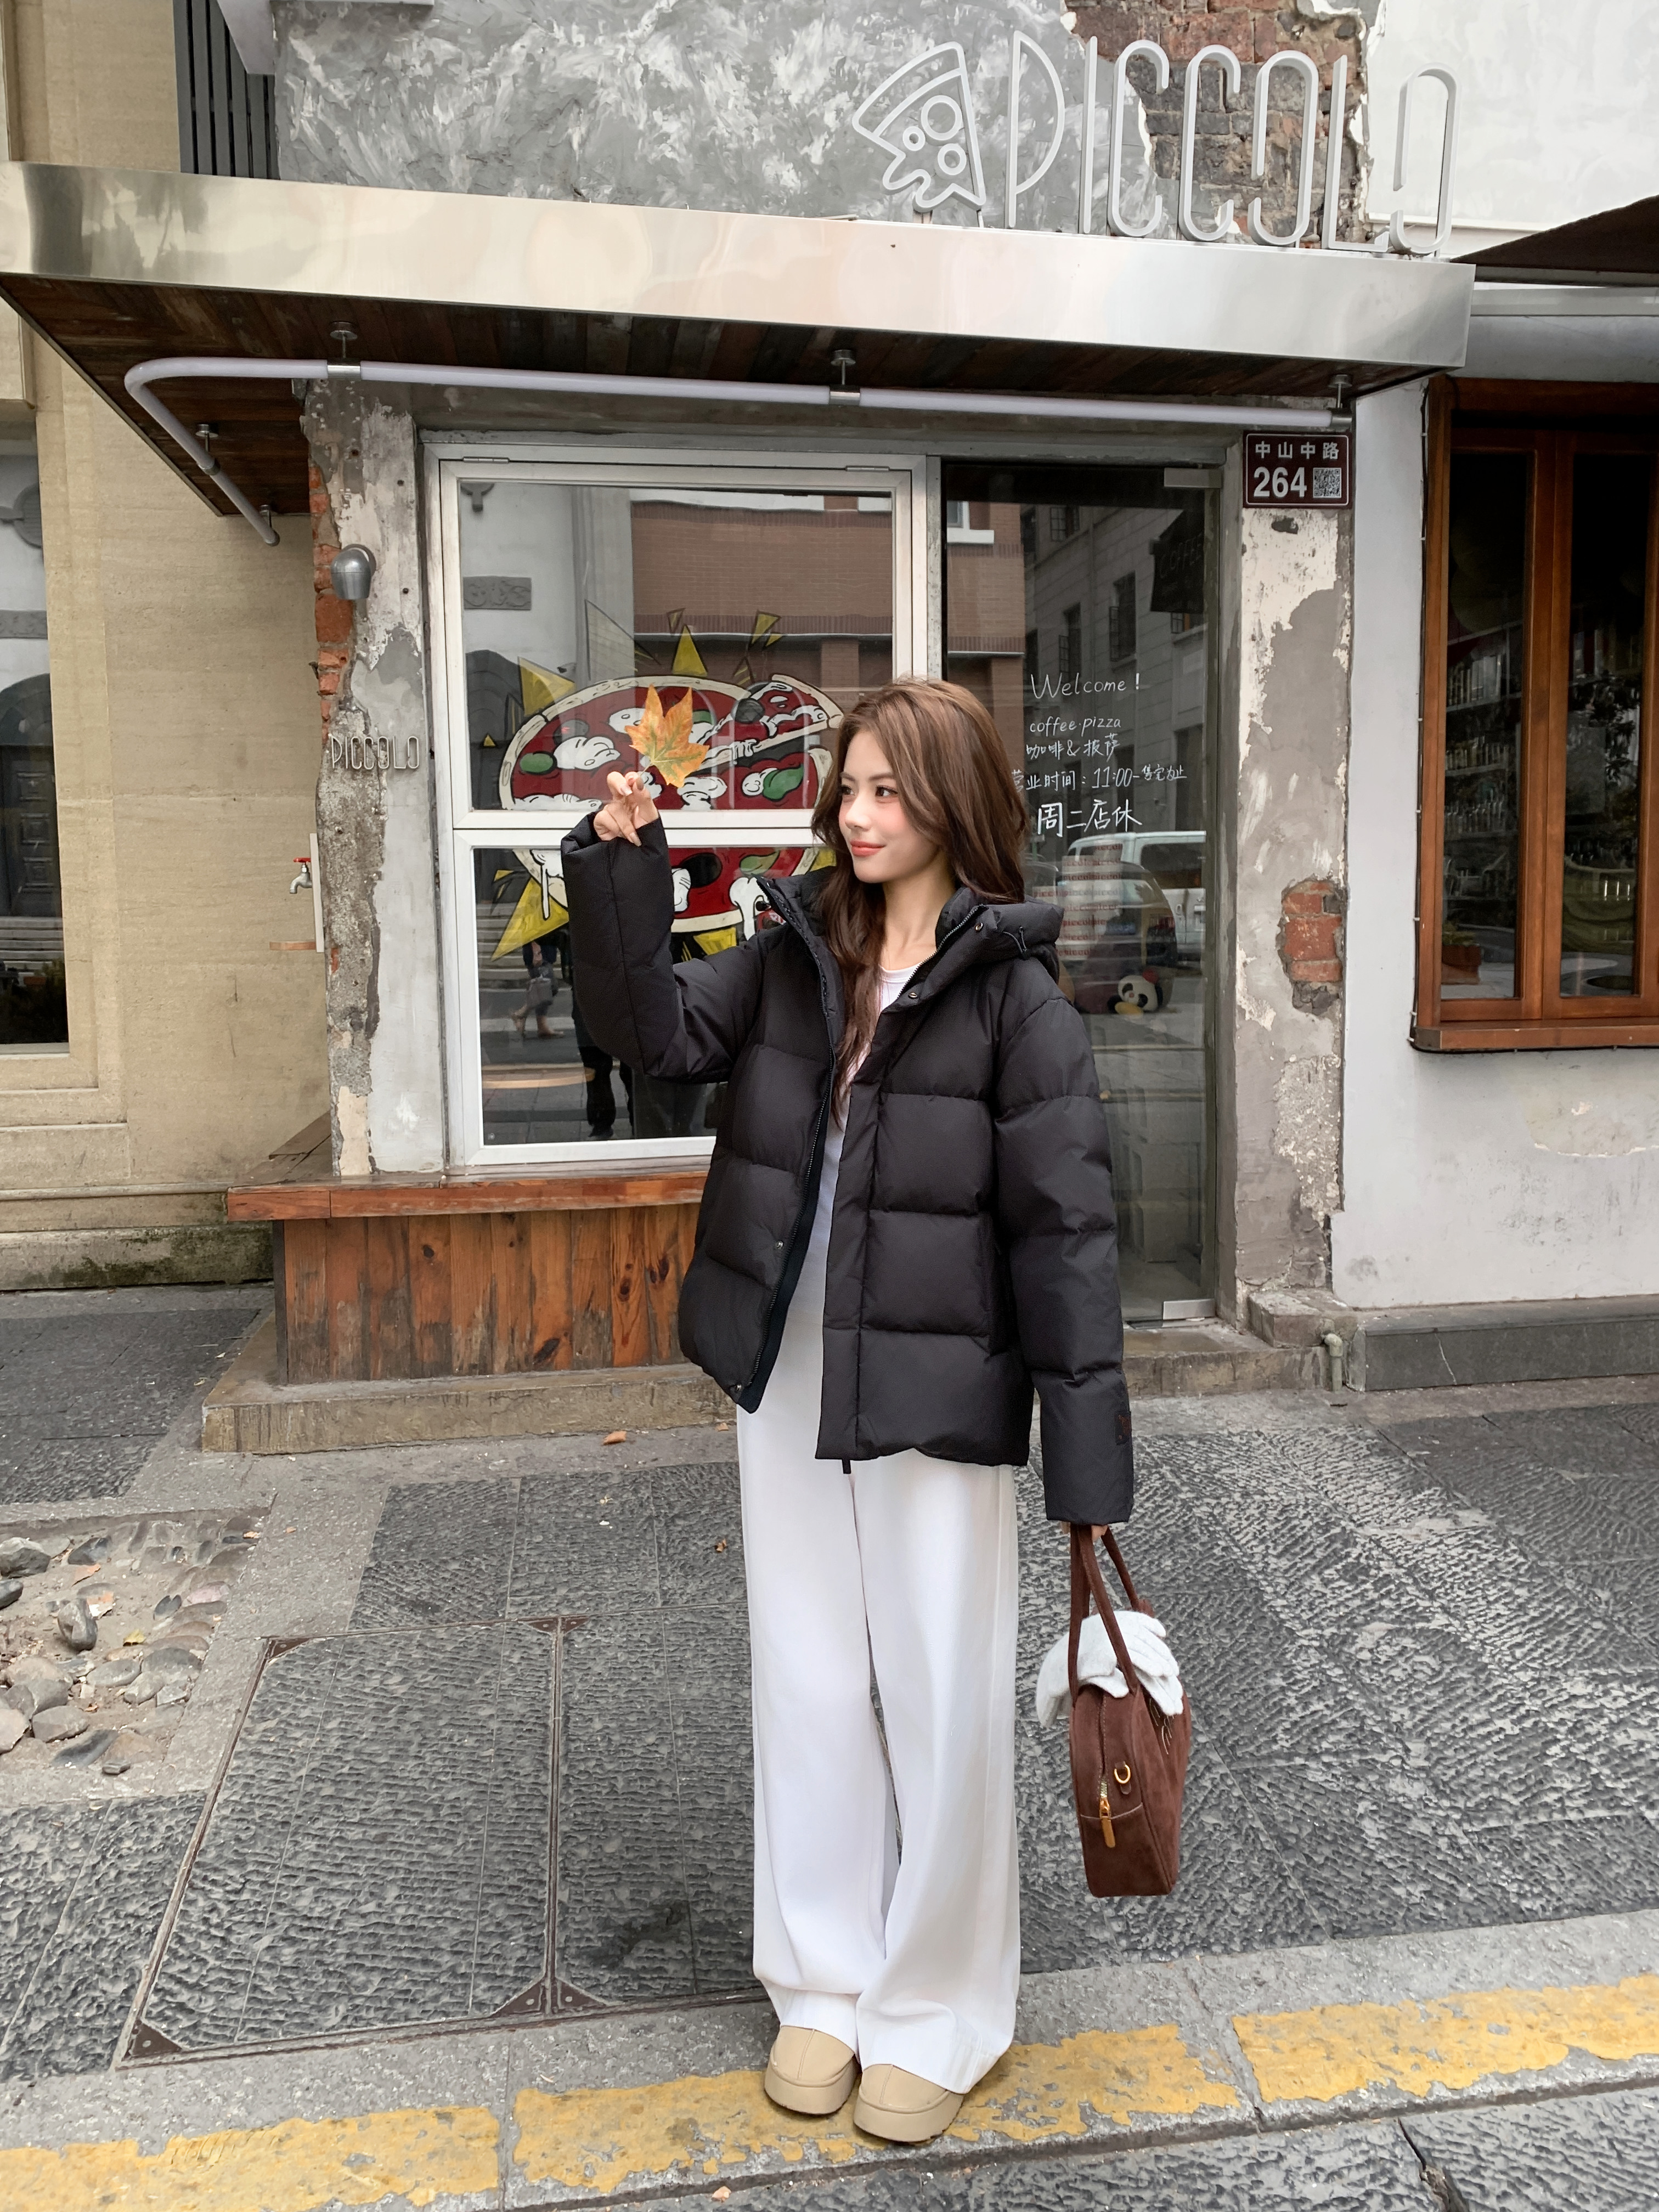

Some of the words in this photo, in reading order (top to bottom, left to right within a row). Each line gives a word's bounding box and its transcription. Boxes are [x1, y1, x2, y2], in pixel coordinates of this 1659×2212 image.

[1007, 31, 1461, 254] PICCOLO
[1255, 441, 1339, 460] 中山中路
[1253, 466, 1307, 498] 264
[331, 735, 419, 769] PICCOLO
[1037, 799, 1143, 837] 周二店休
